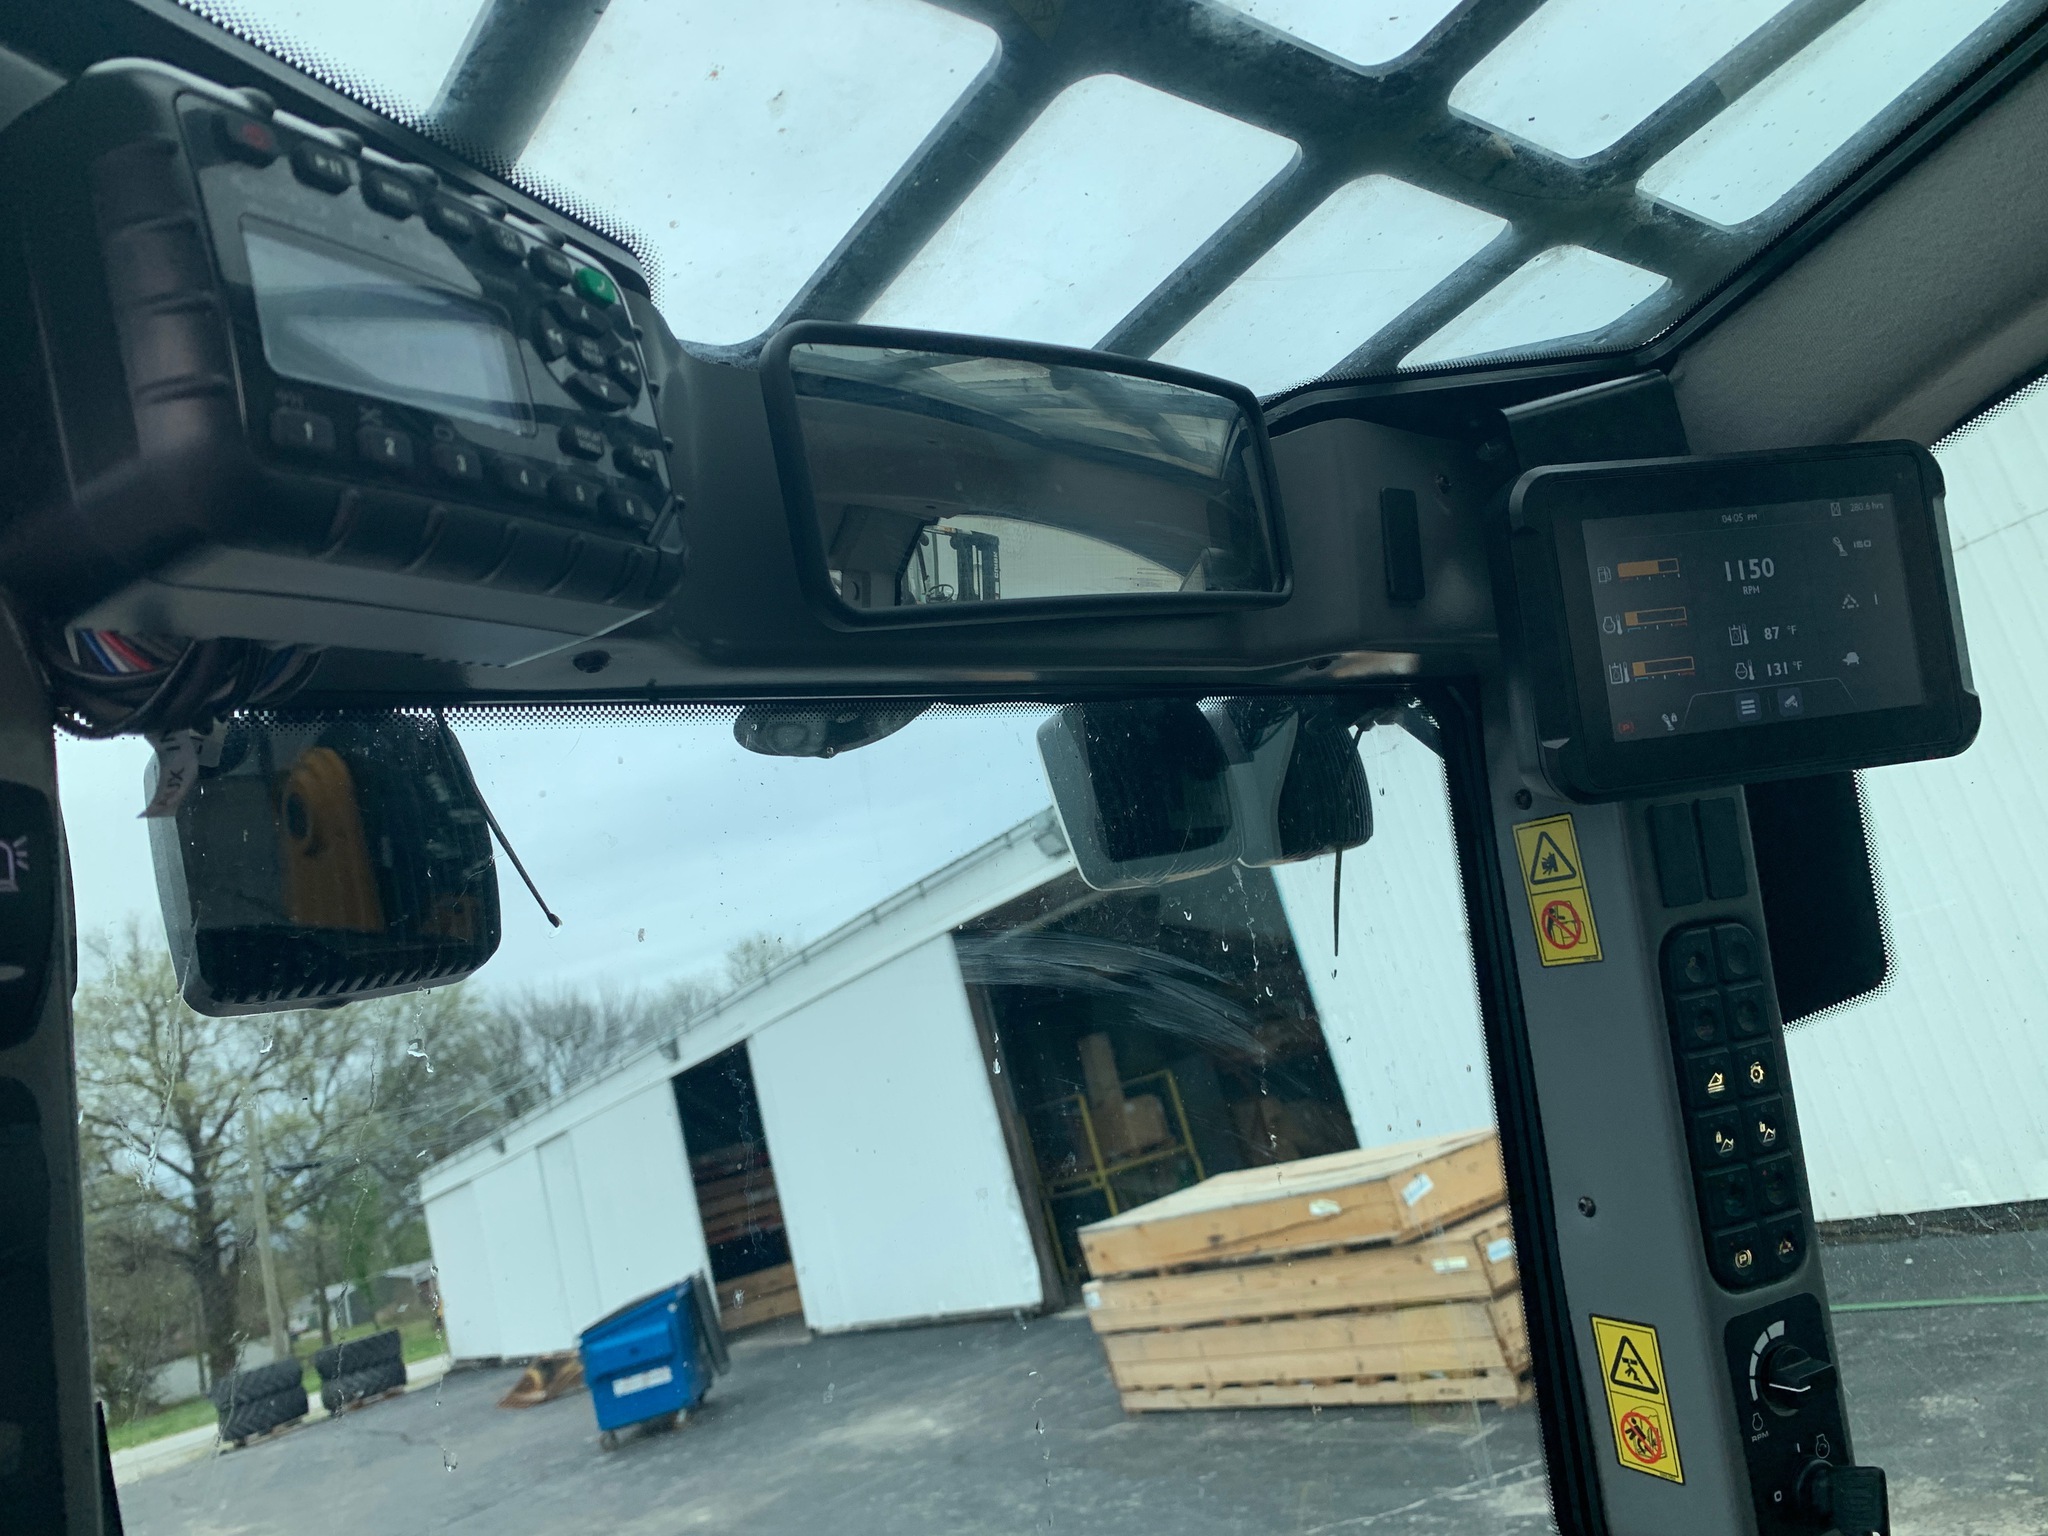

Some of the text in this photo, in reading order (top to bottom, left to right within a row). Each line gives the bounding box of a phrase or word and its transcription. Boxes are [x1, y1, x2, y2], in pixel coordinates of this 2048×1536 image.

[303, 421, 313, 443] 1
[384, 436, 396, 457] 2
[456, 454, 467, 473] 3
[520, 469, 530, 486] 4
[1747, 513, 1758, 521] PM
[1853, 539, 1872, 549] ISO
[1724, 557, 1775, 582] 1150
[1742, 585, 1760, 596] RPM
[1764, 626, 1780, 640] 87
[1766, 661, 1789, 677] 131
[1751, 1430, 1769, 1443] RPM
